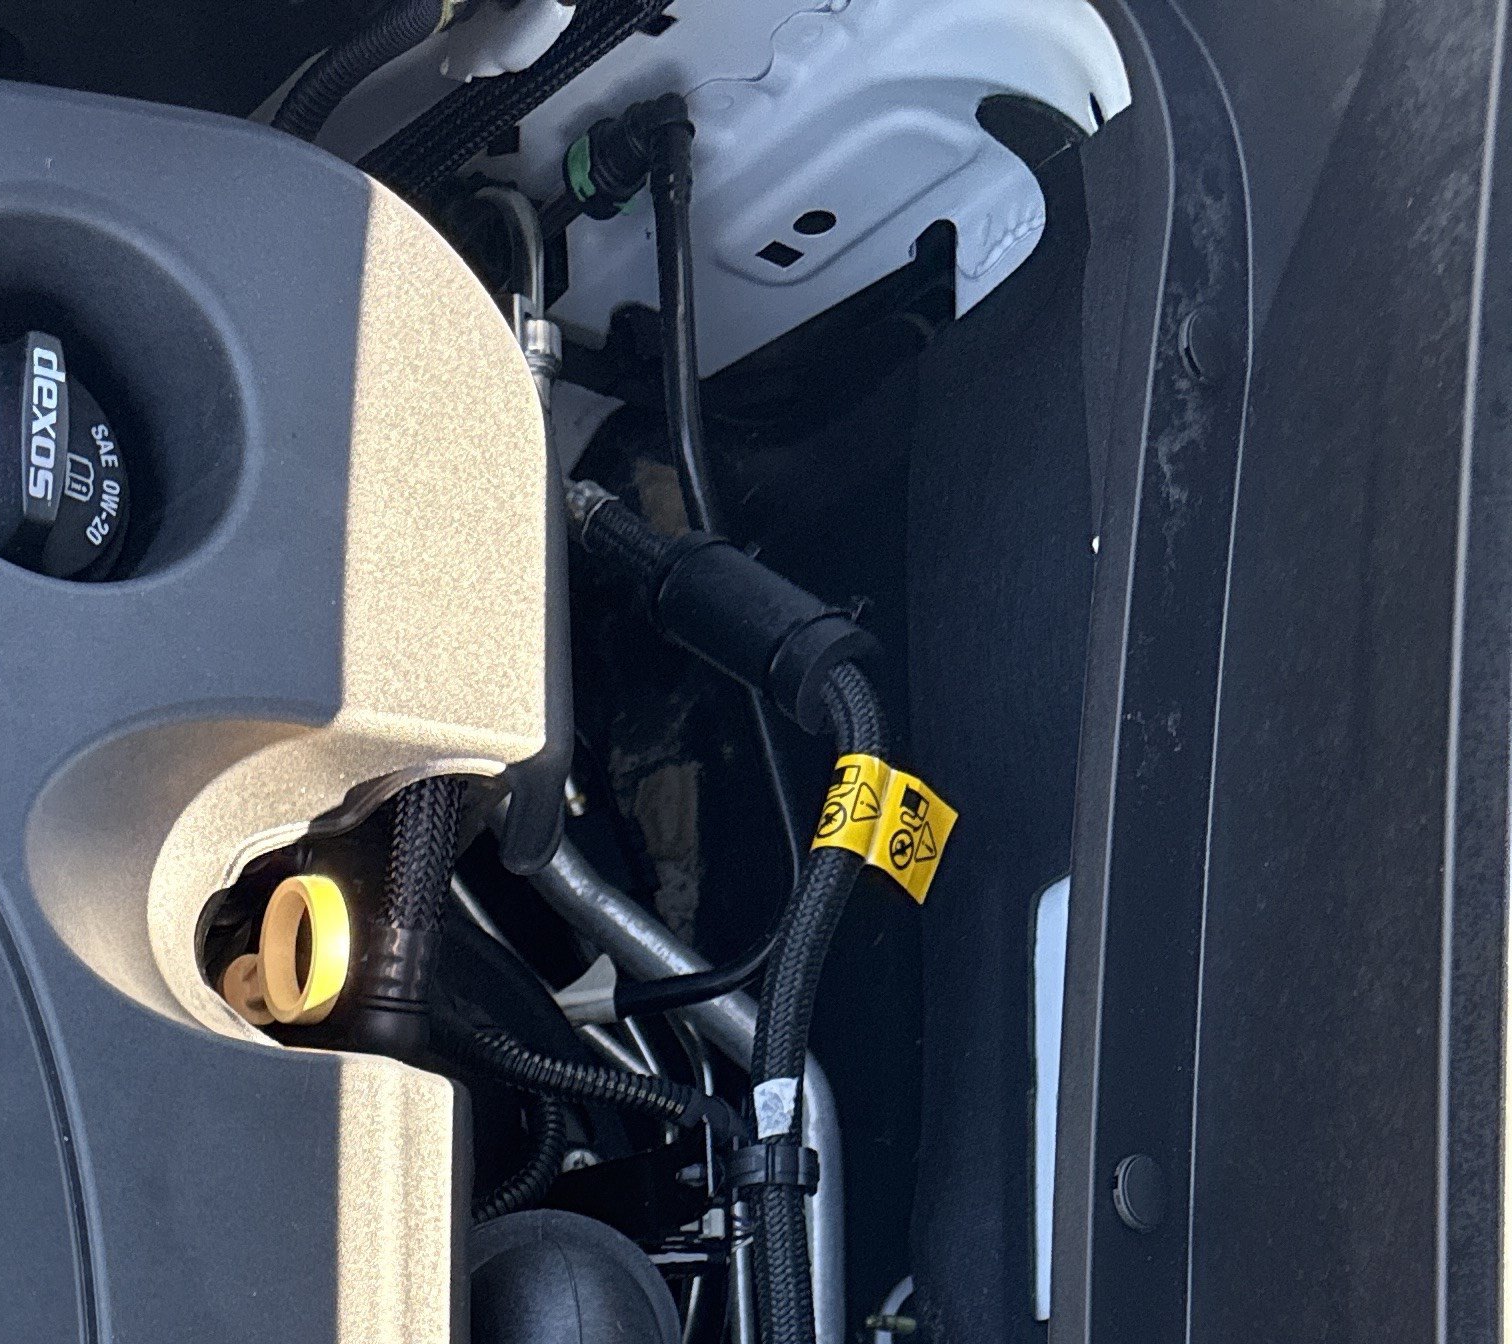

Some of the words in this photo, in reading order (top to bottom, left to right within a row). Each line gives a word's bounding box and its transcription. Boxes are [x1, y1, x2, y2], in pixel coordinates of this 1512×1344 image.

[29, 347, 66, 501] dexos
[90, 424, 119, 468] SAE
[86, 479, 120, 546] 0W-20
